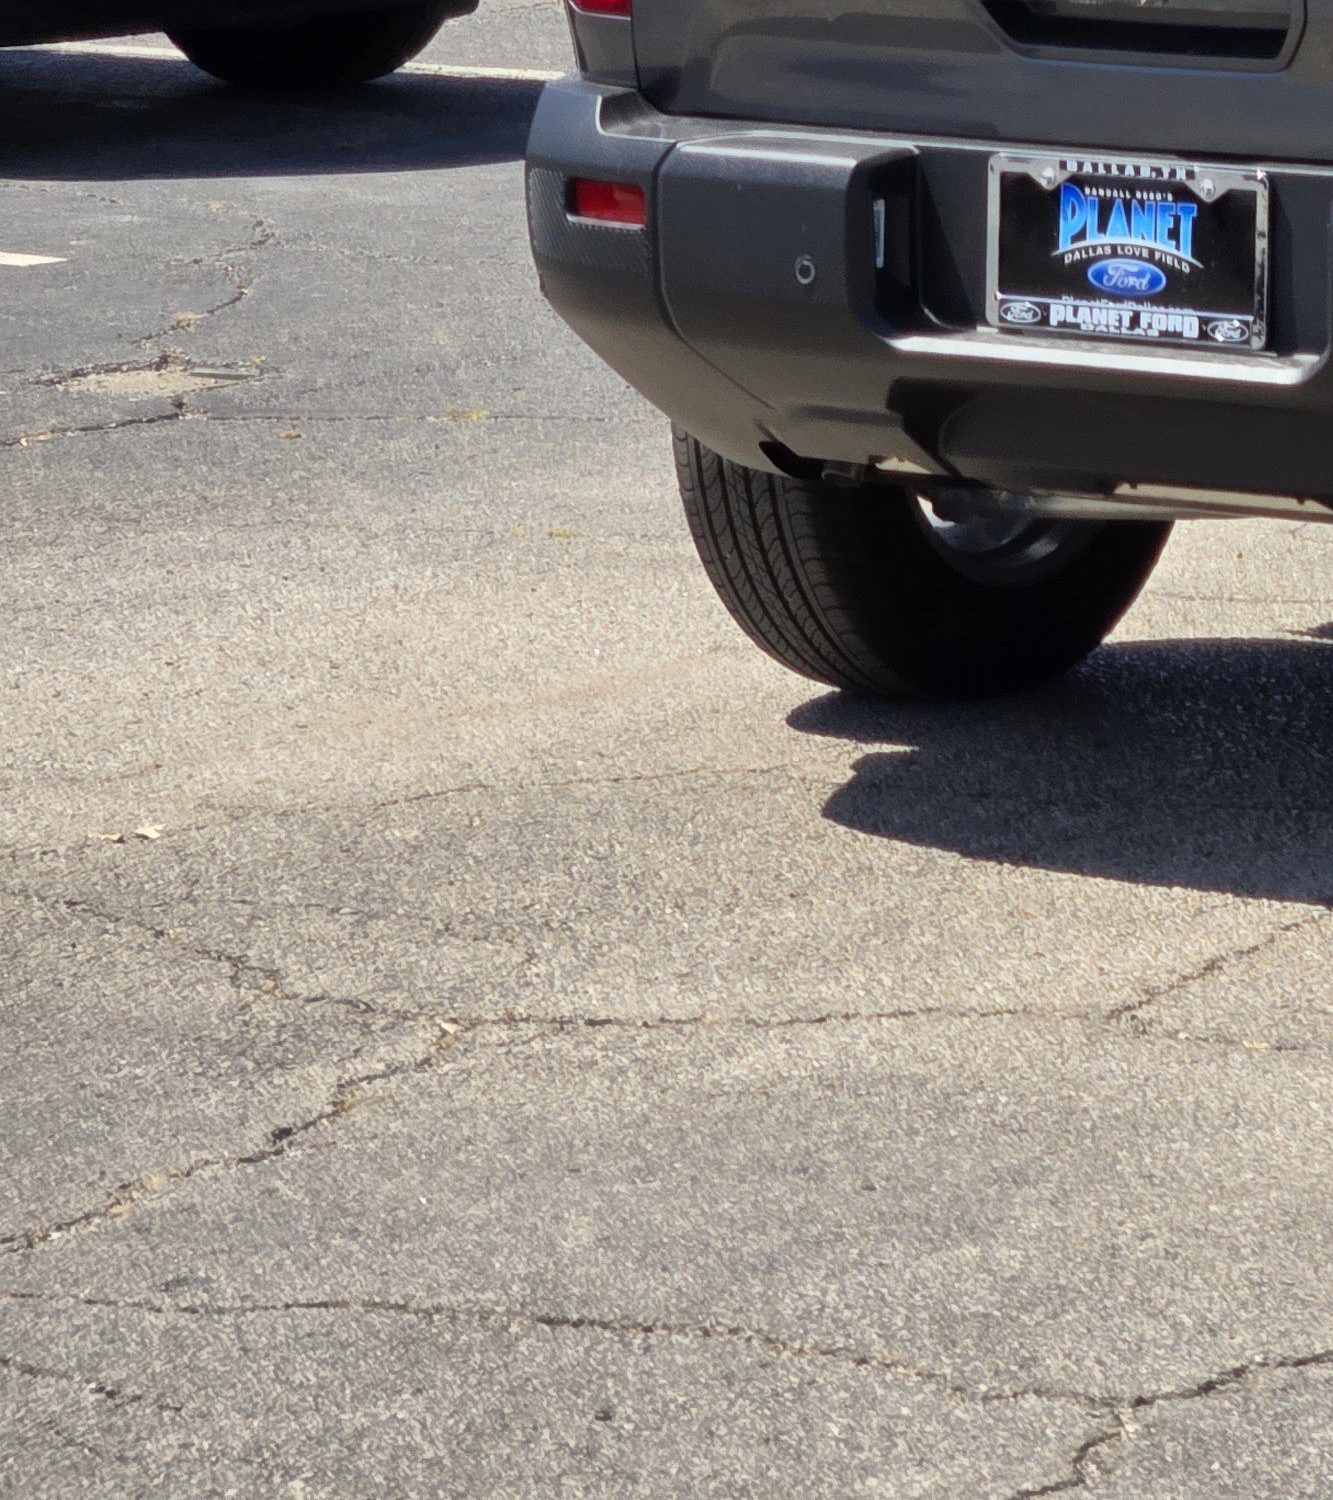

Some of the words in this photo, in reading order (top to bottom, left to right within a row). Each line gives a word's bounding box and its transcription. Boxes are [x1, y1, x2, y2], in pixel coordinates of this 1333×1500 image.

[1059, 182, 1197, 258] PLANET
[1064, 244, 1112, 265] DALLAS
[1117, 245, 1149, 258] LOVE
[1154, 251, 1190, 274] FIELD
[1103, 264, 1151, 291] Ford
[1051, 303, 1133, 327] PLANET
[1140, 311, 1199, 338] FORD
